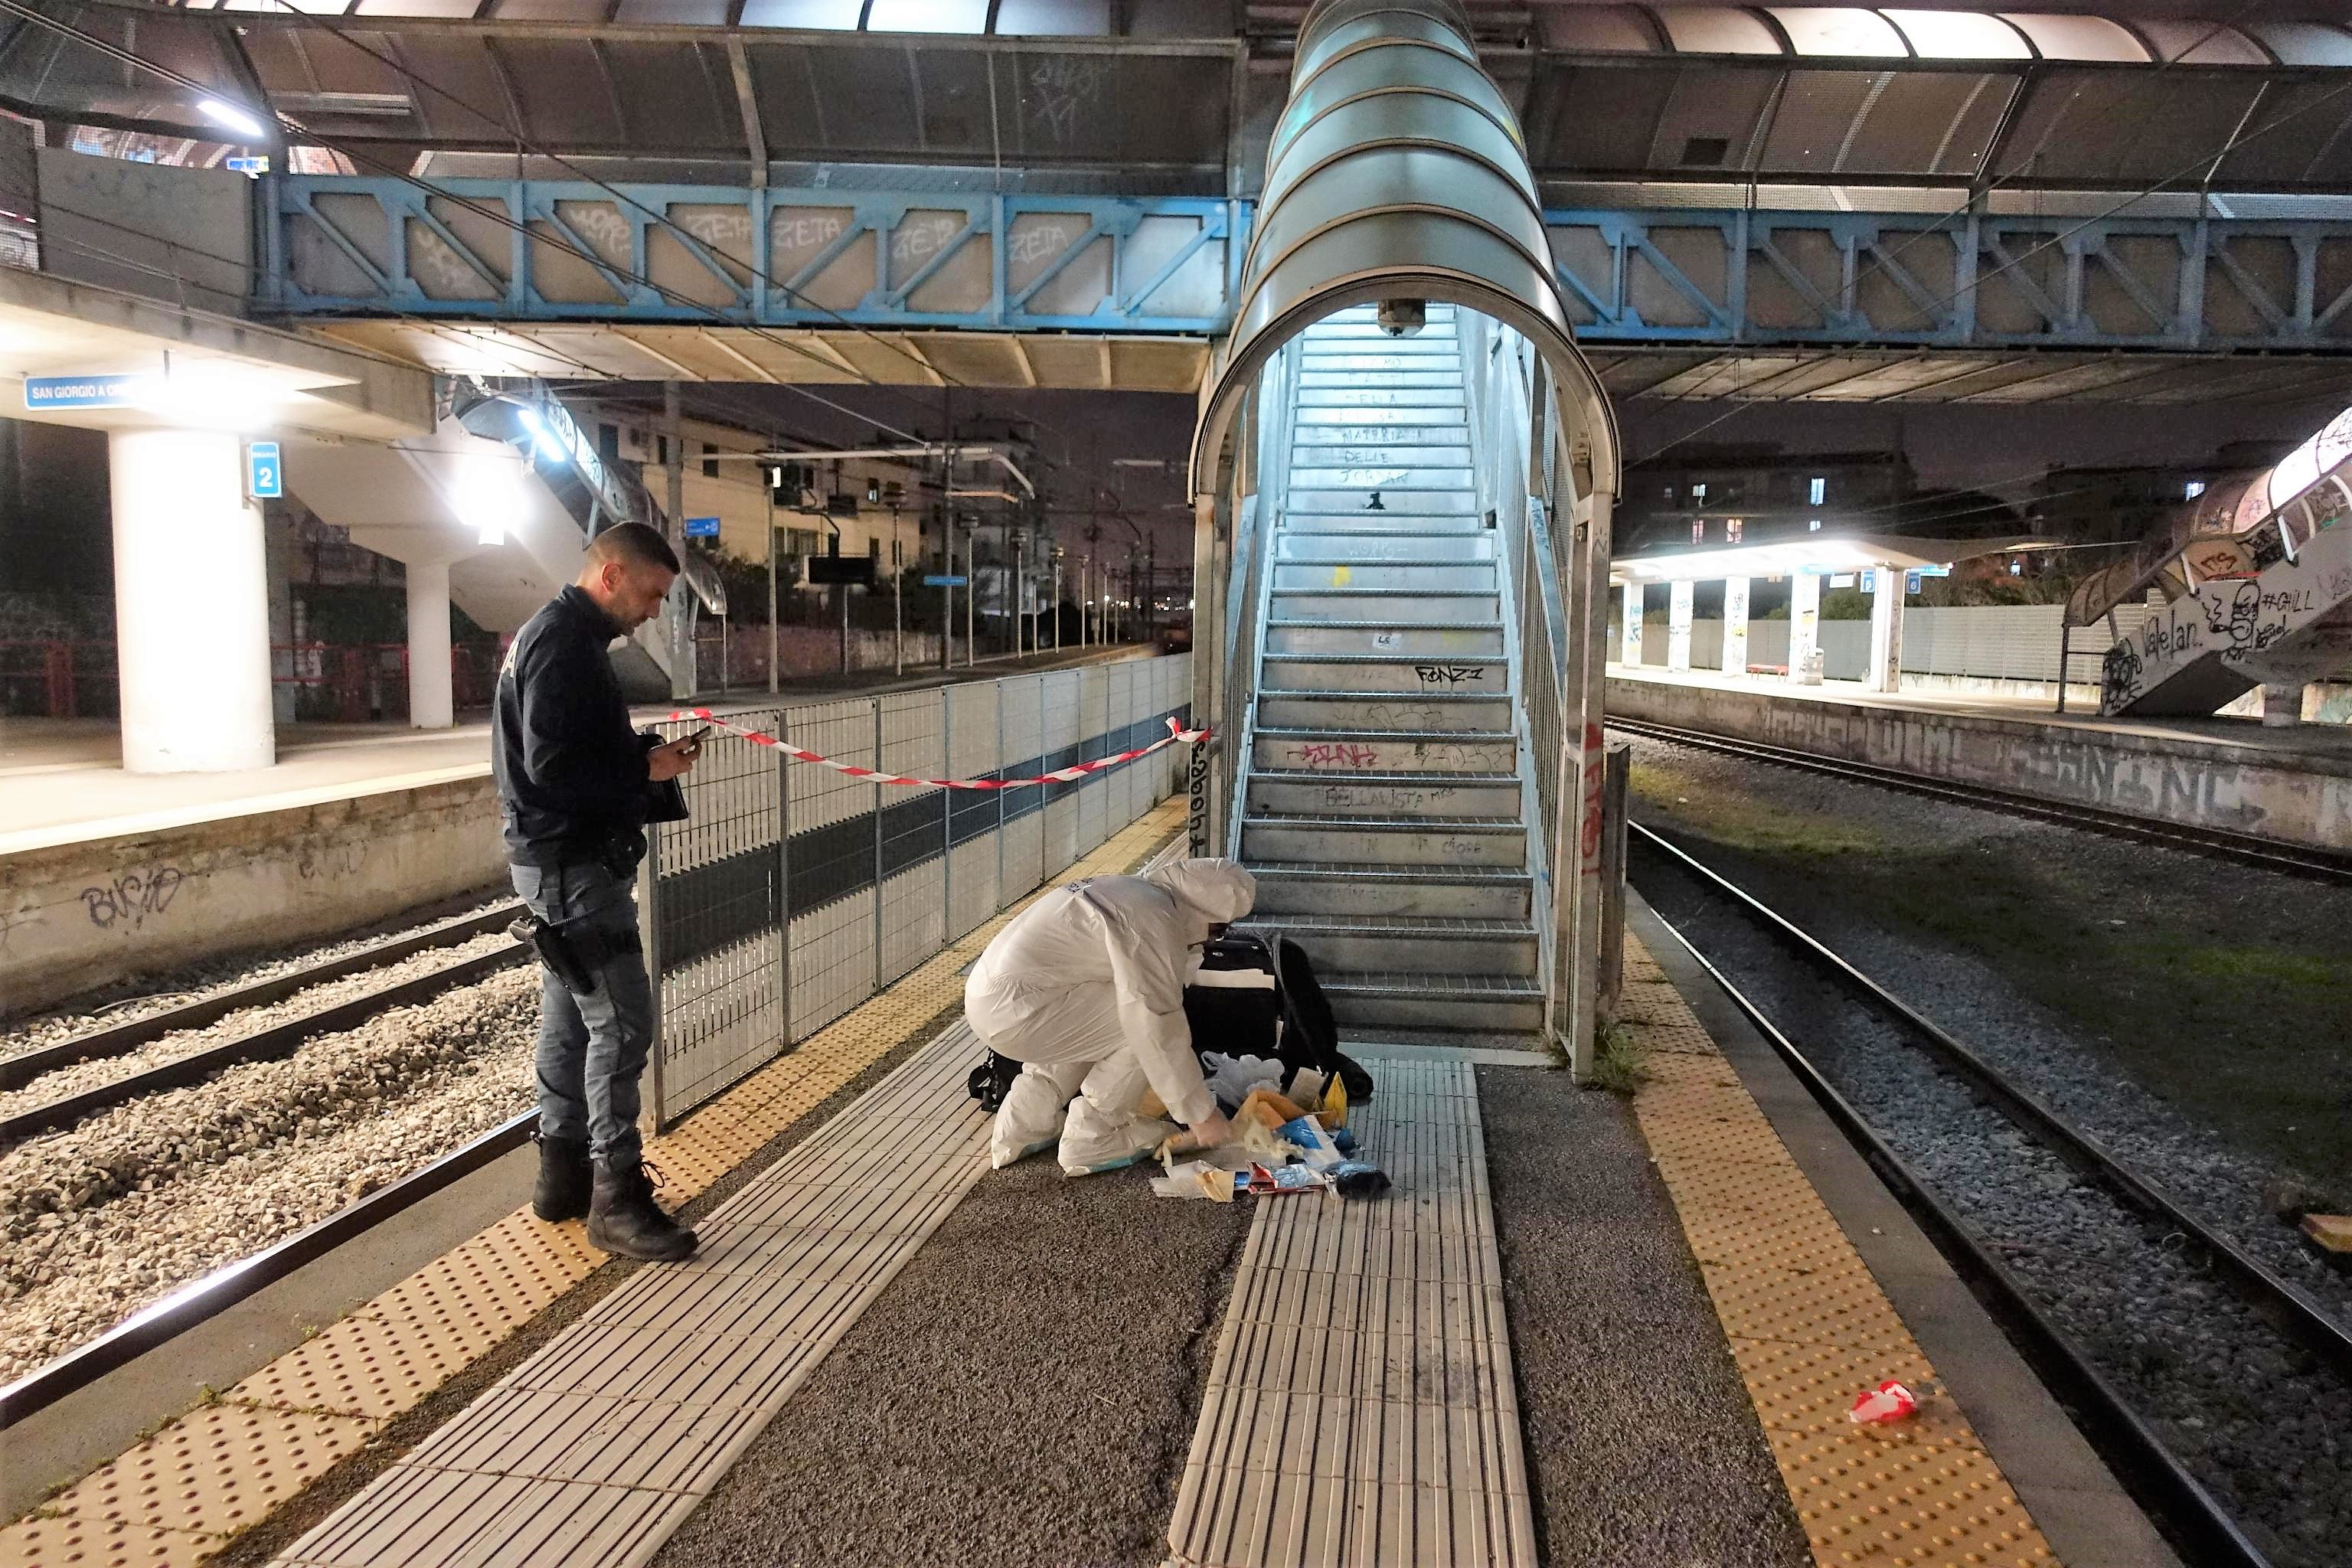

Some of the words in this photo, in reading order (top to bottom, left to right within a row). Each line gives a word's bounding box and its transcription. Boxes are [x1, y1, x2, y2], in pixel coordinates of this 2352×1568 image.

[32, 387, 52, 400] SAN
[54, 385, 96, 399] GIORGIO
[98, 384, 106, 397] A
[259, 466, 273, 488] 2
